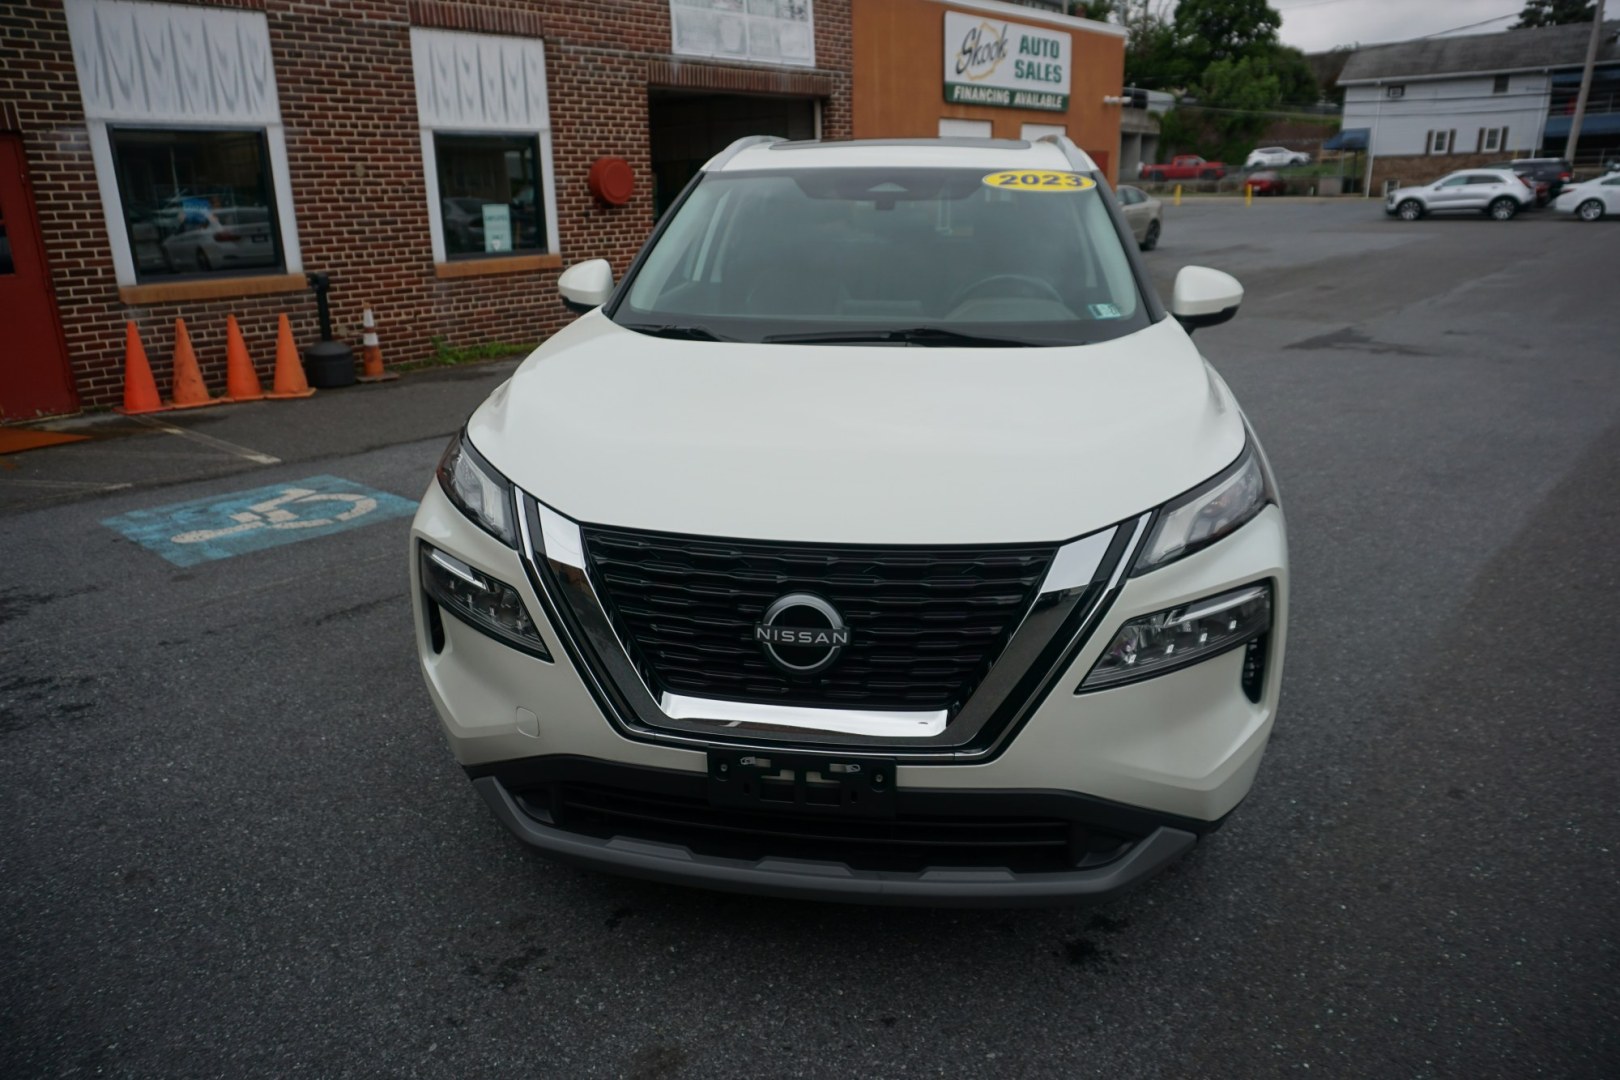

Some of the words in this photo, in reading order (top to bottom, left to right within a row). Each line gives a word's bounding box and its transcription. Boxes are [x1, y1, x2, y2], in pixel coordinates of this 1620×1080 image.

[1019, 35, 1060, 60] AUTO
[1014, 60, 1062, 84] SALES
[954, 85, 1010, 105] FINANCING
[1014, 92, 1063, 109] AVAILABLE
[999, 174, 1084, 187] 2023
[756, 627, 848, 644] NISSAN
